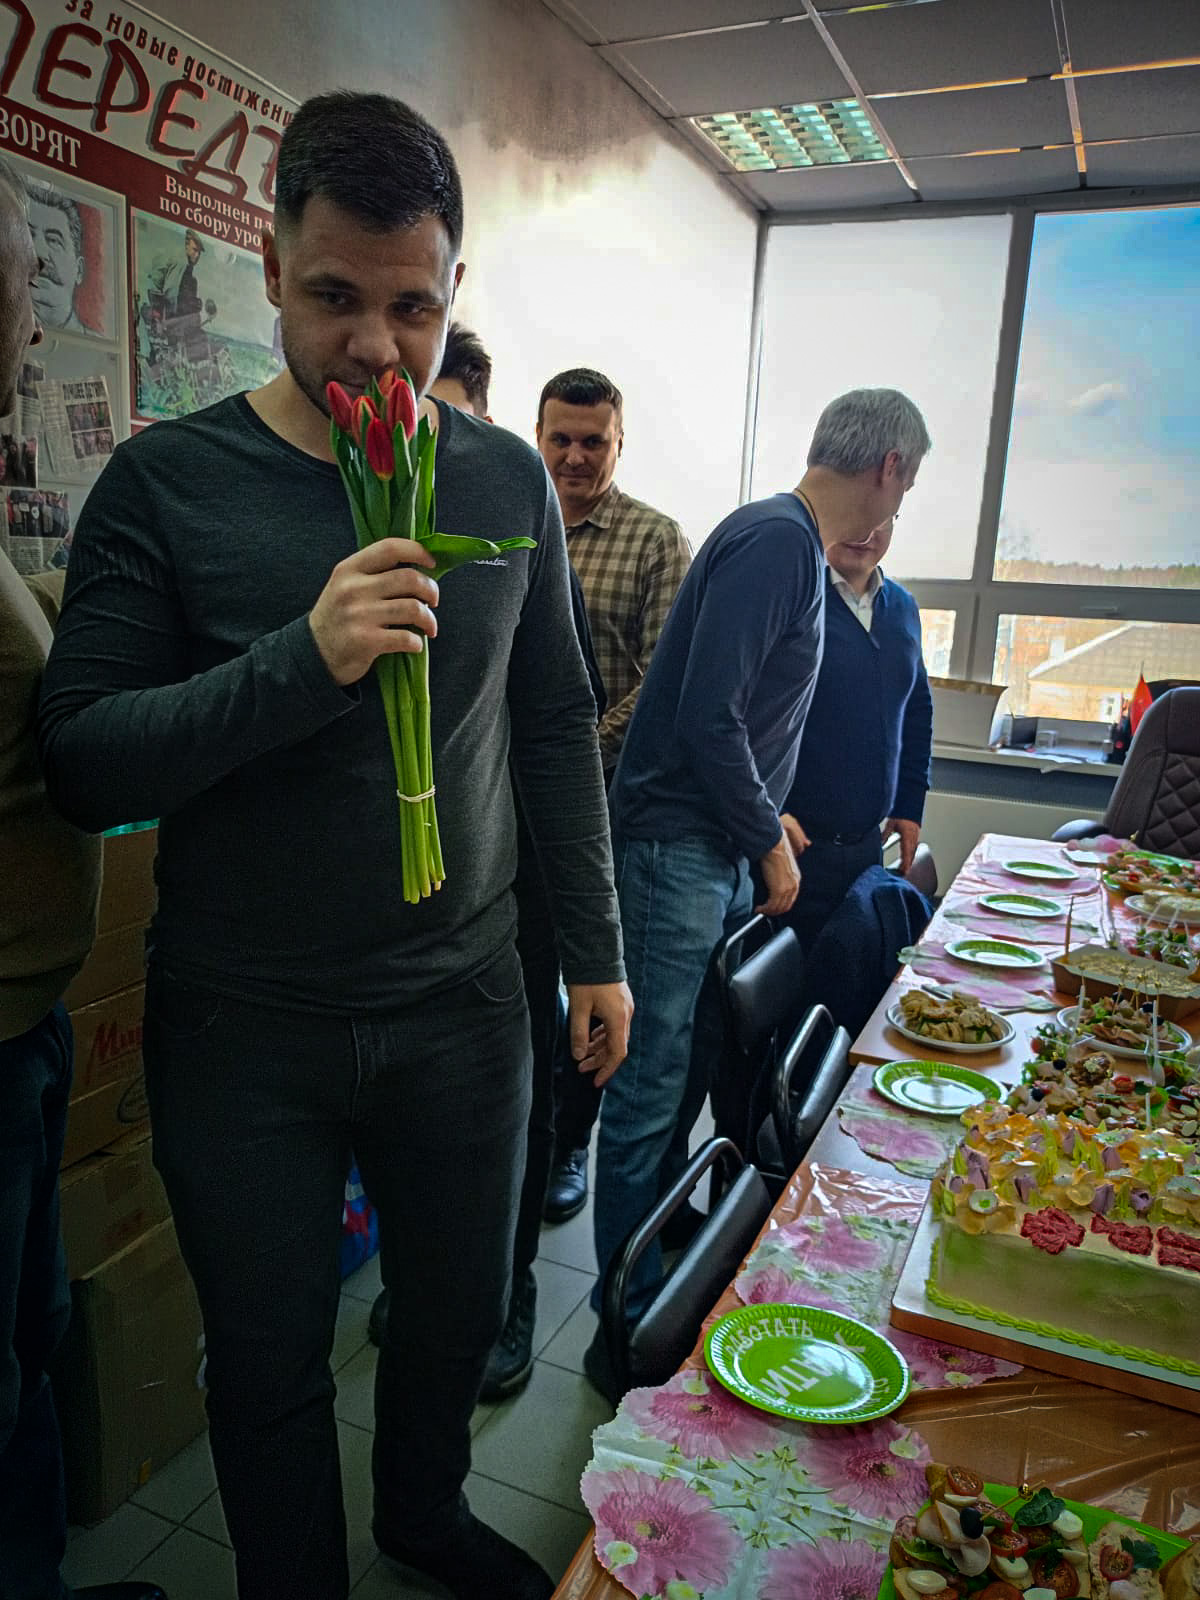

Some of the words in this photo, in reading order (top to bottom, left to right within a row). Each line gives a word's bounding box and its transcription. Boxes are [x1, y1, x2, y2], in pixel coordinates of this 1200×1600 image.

[106, 13, 178, 65] новые
[160, 197, 180, 215] по
[185, 208, 231, 238] сбору
[165, 174, 250, 225] Выполнен
